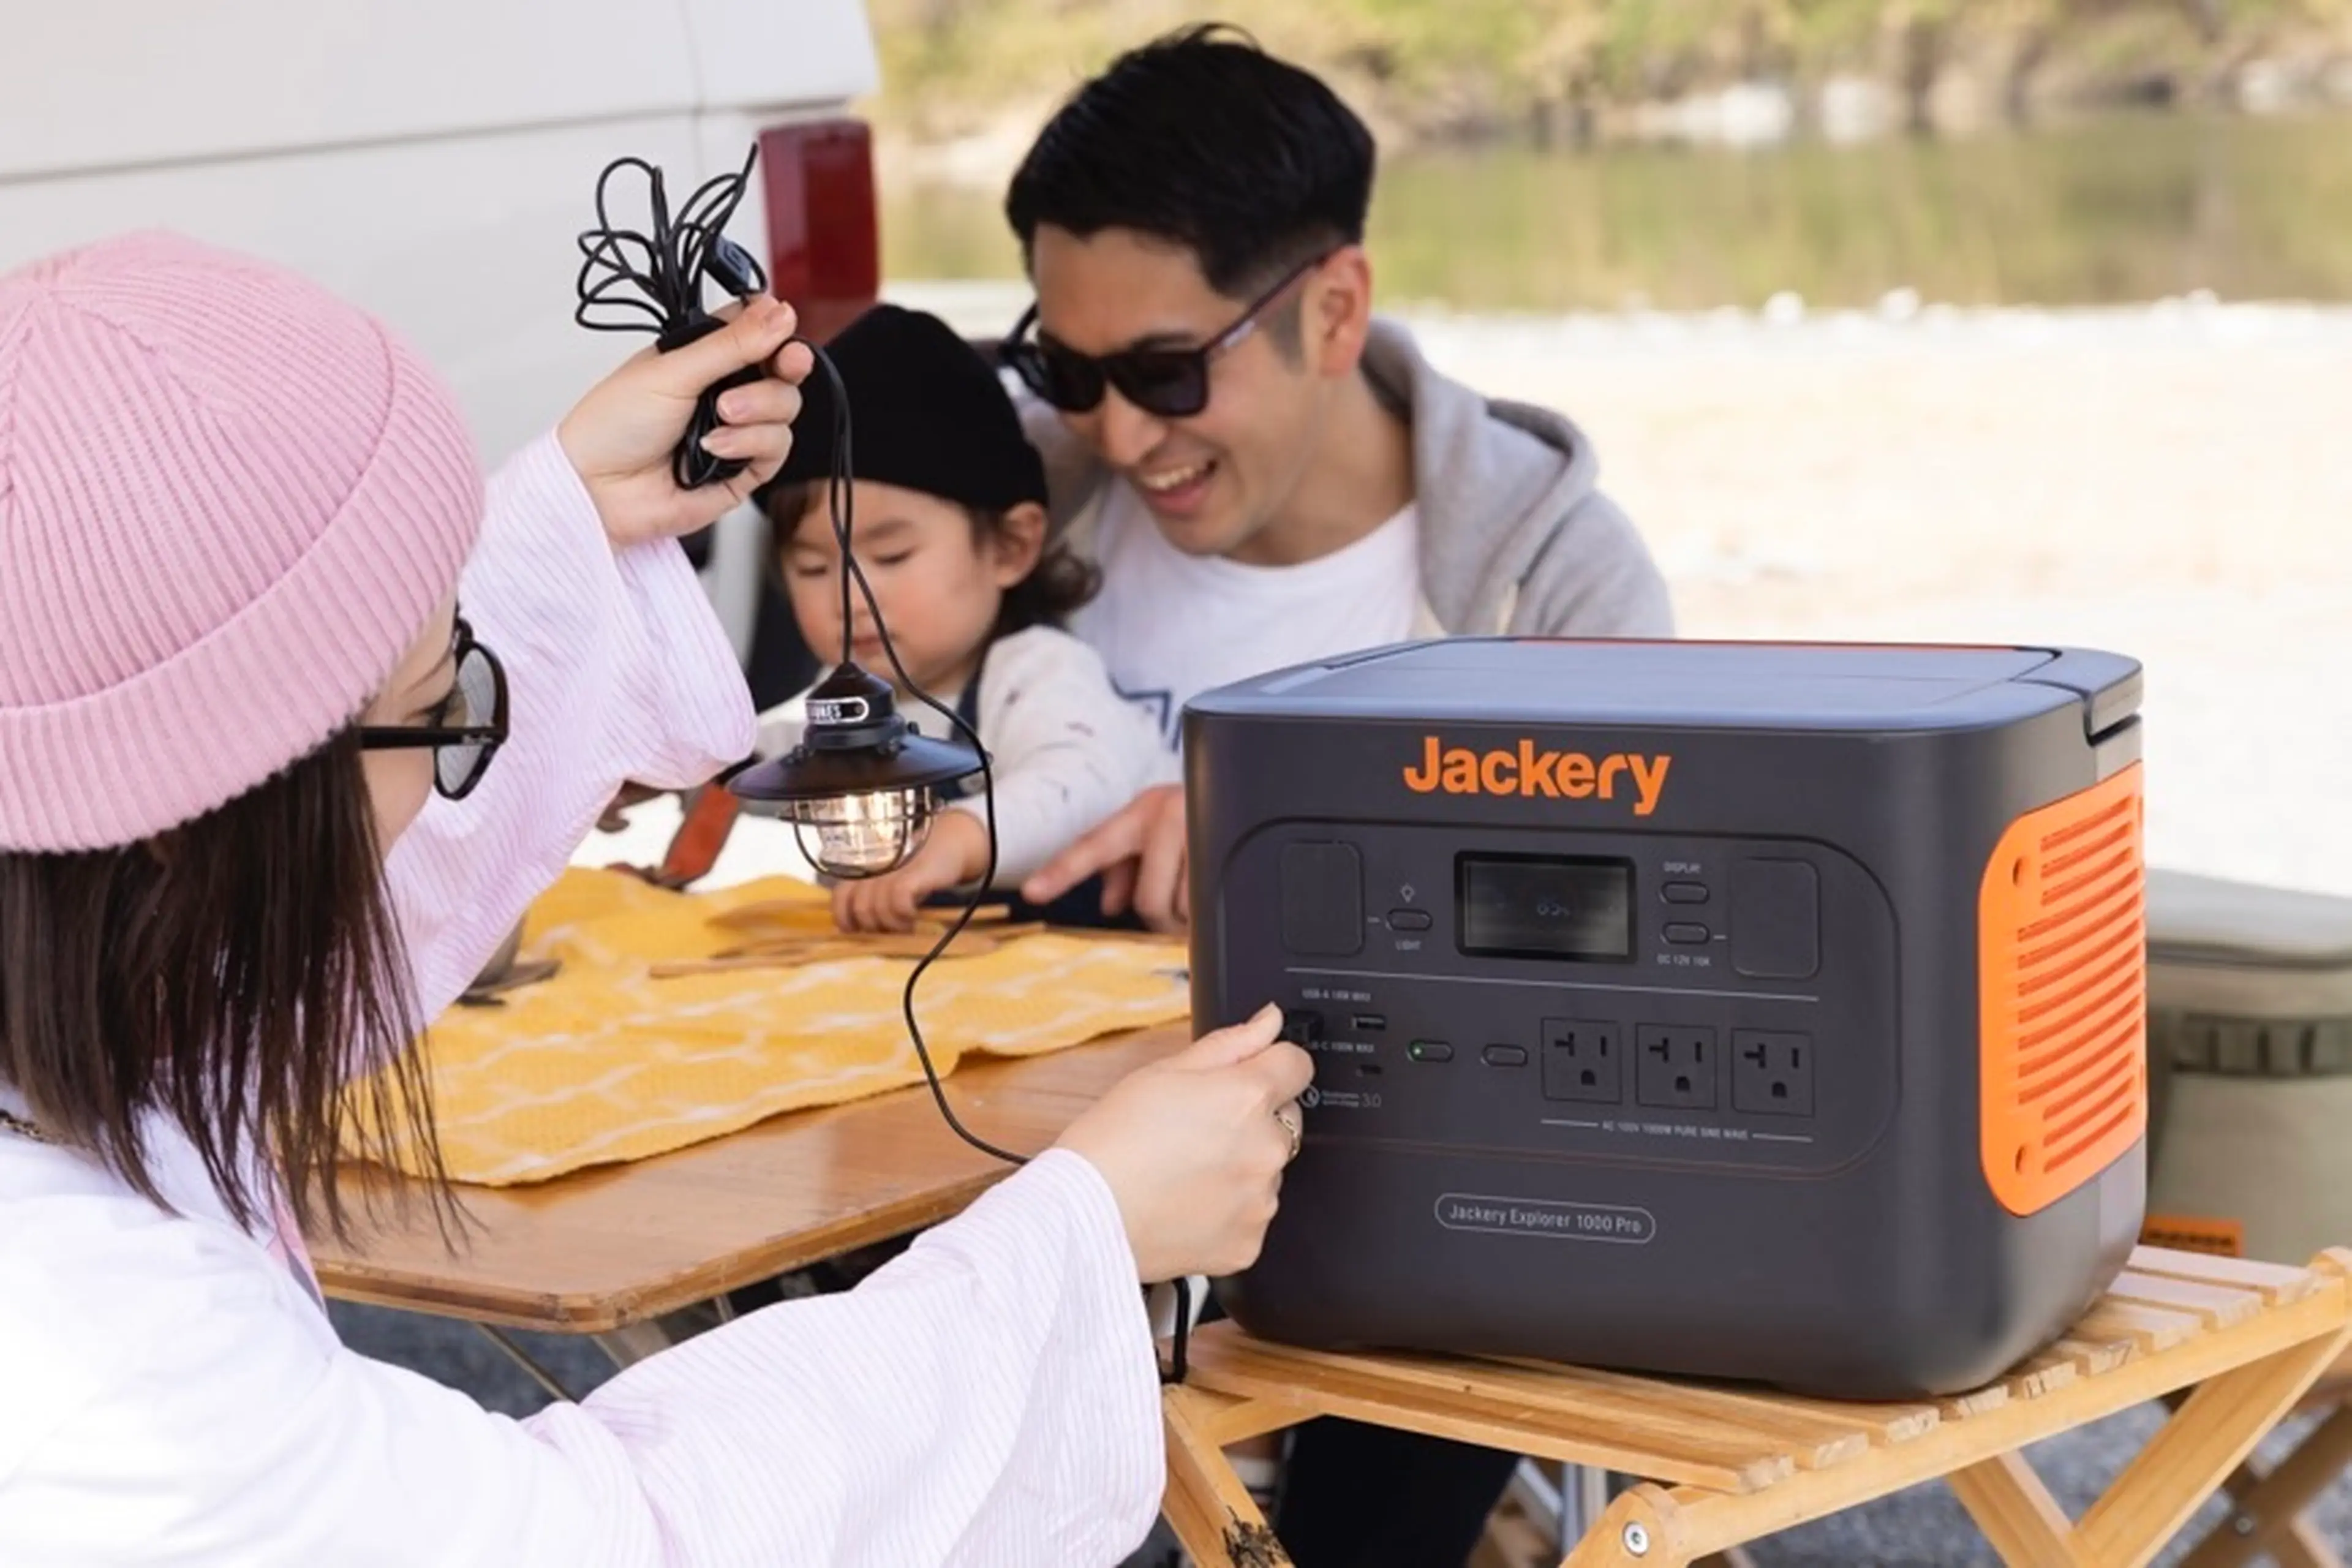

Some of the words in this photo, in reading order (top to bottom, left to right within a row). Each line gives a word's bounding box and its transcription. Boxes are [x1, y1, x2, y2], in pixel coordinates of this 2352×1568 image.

[1403, 736, 1672, 815] Jackery
[1448, 1204, 1506, 1226] Jackery
[1510, 1208, 1571, 1229] Explorer
[1577, 1215, 1613, 1232] 1000
[1616, 1216, 1642, 1235] Pro
